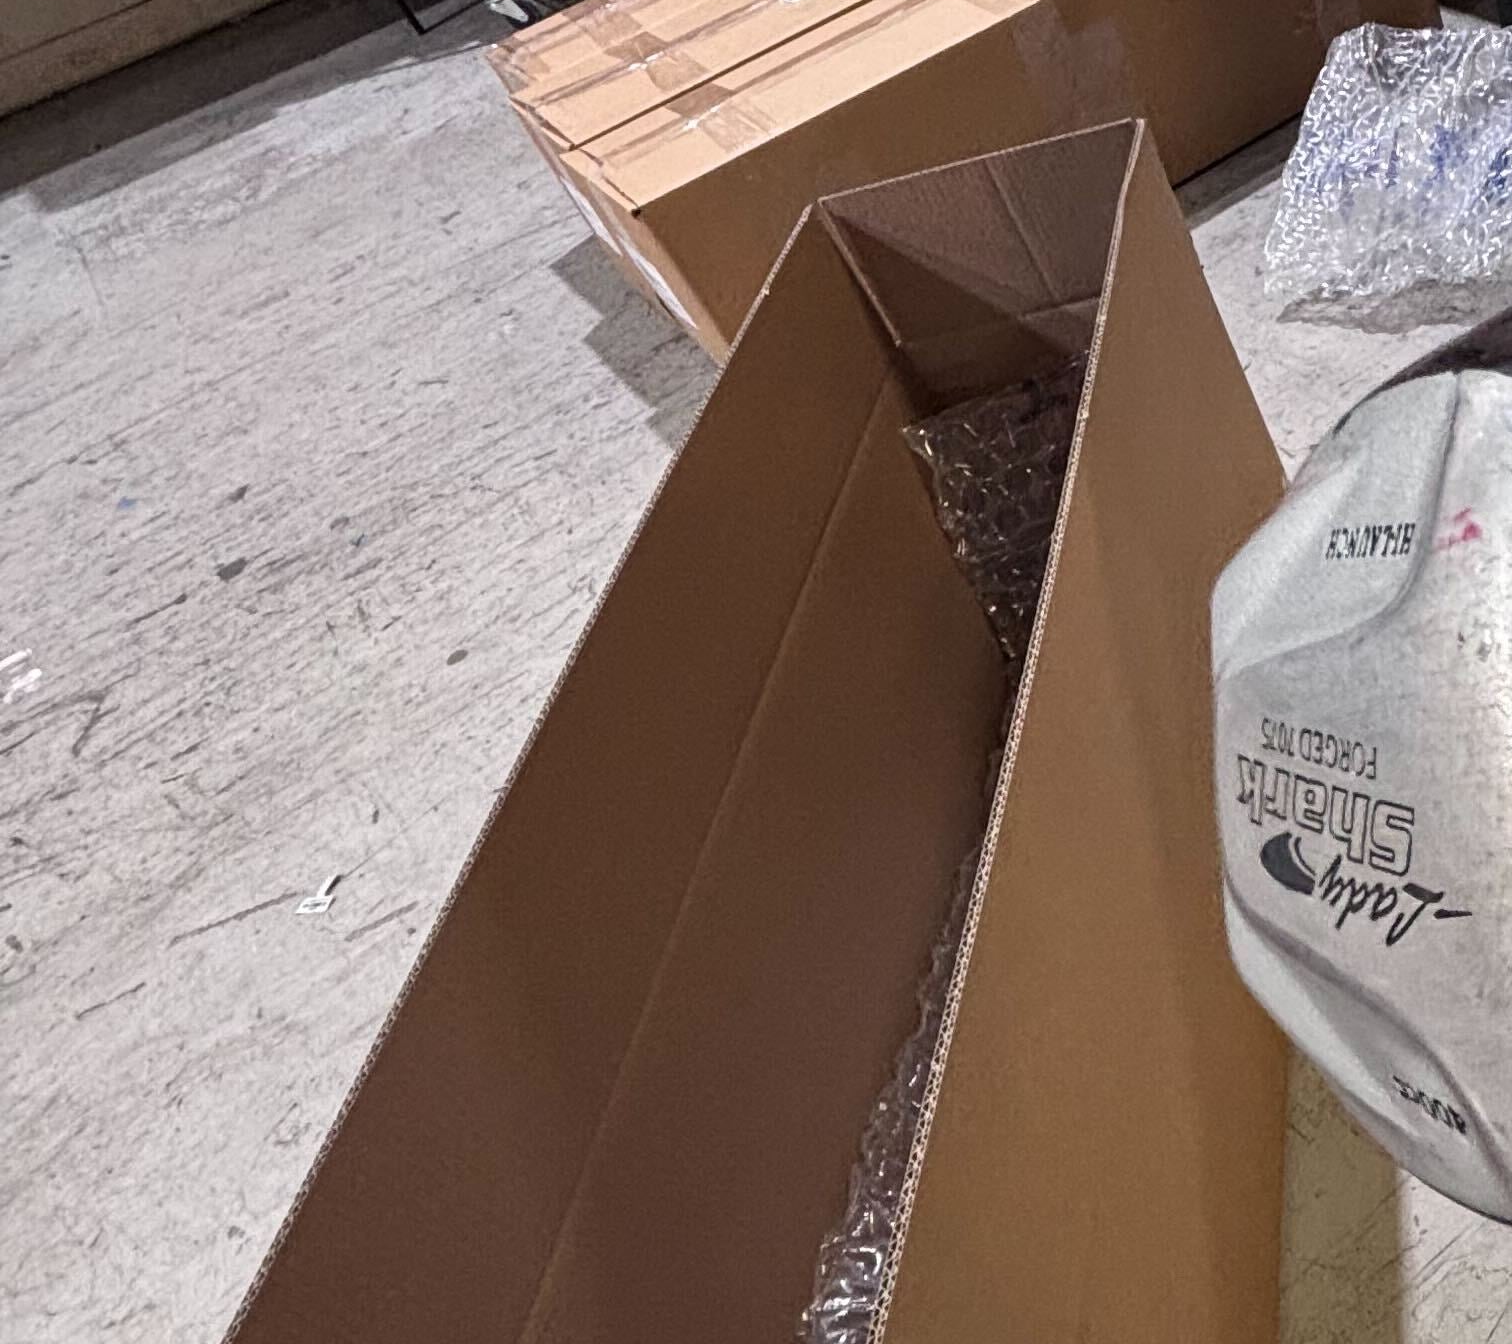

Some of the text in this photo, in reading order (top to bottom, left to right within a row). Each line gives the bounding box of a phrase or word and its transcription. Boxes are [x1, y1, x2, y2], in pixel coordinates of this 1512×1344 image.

[1299, 727, 1377, 780] FORGED
[1236, 752, 1415, 877] Shark
[1317, 853, 1445, 947] Lady
